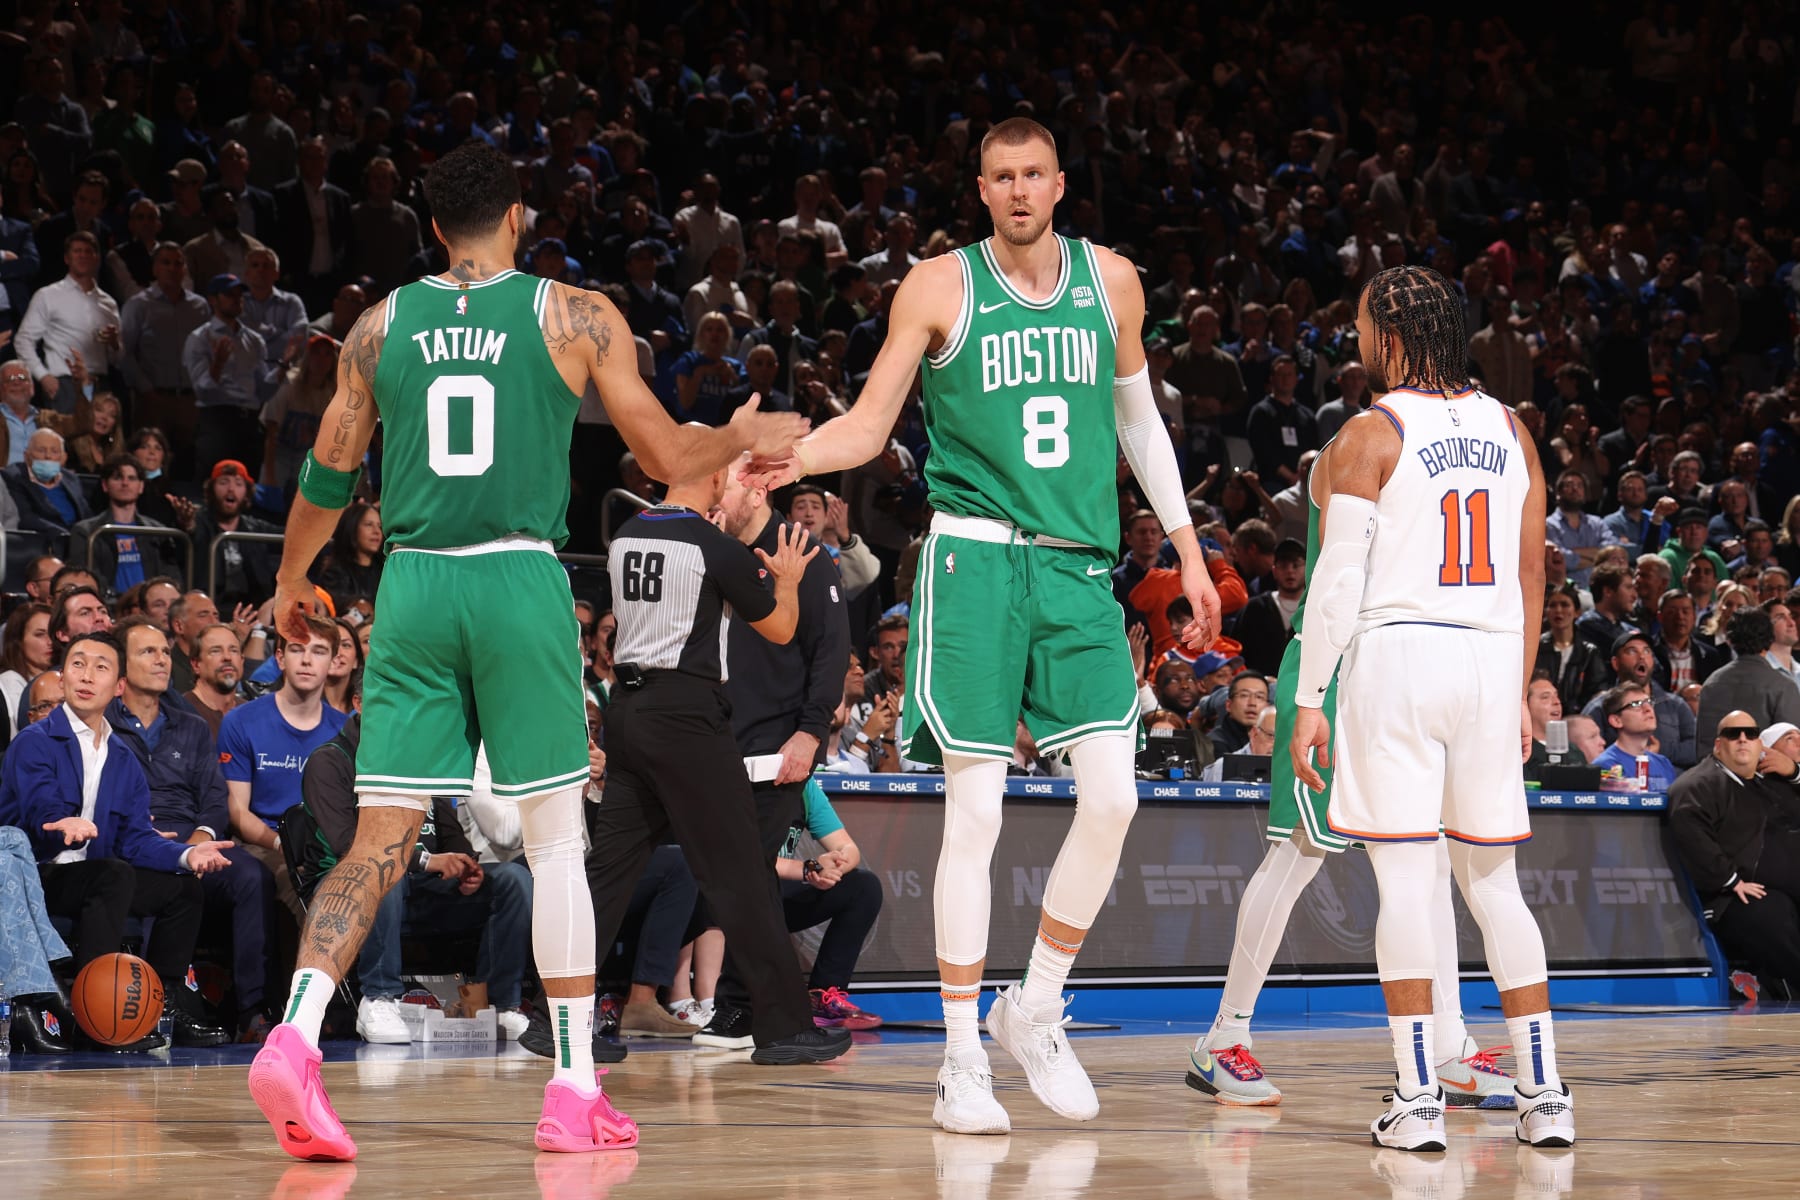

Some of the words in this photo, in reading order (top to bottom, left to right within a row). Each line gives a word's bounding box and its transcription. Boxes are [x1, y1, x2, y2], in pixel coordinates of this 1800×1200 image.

[1071, 286, 1095, 299] VISTA
[1073, 298, 1095, 309] PRINT
[411, 327, 507, 365] TATUM
[981, 326, 1098, 393] BOSTON
[327, 387, 365, 469] Deuc
[427, 375, 495, 477] 0
[1022, 395, 1070, 468] 8
[1417, 437, 1508, 478] BRUNSON
[1438, 489, 1495, 587] 11
[623, 551, 665, 603] 68
[841, 780, 870, 791] CHASE
[889, 782, 917, 792] CHASE
[1025, 784, 1053, 794] CHASE
[1154, 787, 1180, 797] CHASE
[1195, 788, 1220, 797] CHASE
[1236, 789, 1260, 799] CHASE
[1540, 795, 1562, 804] CHASE
[1574, 795, 1596, 804] CHASE
[1608, 796, 1630, 805] CHASE
[1641, 797, 1664, 806] CHASE
[887, 870, 921, 897] VS
[1140, 865, 1246, 904] ESPN
[1516, 869, 1578, 904] EXT
[1591, 868, 1681, 904] ESPN
[122, 962, 142, 1020] Wilson
[454, 1030, 470, 1038] SQUARE
[471, 1030, 488, 1038] GARDEN
